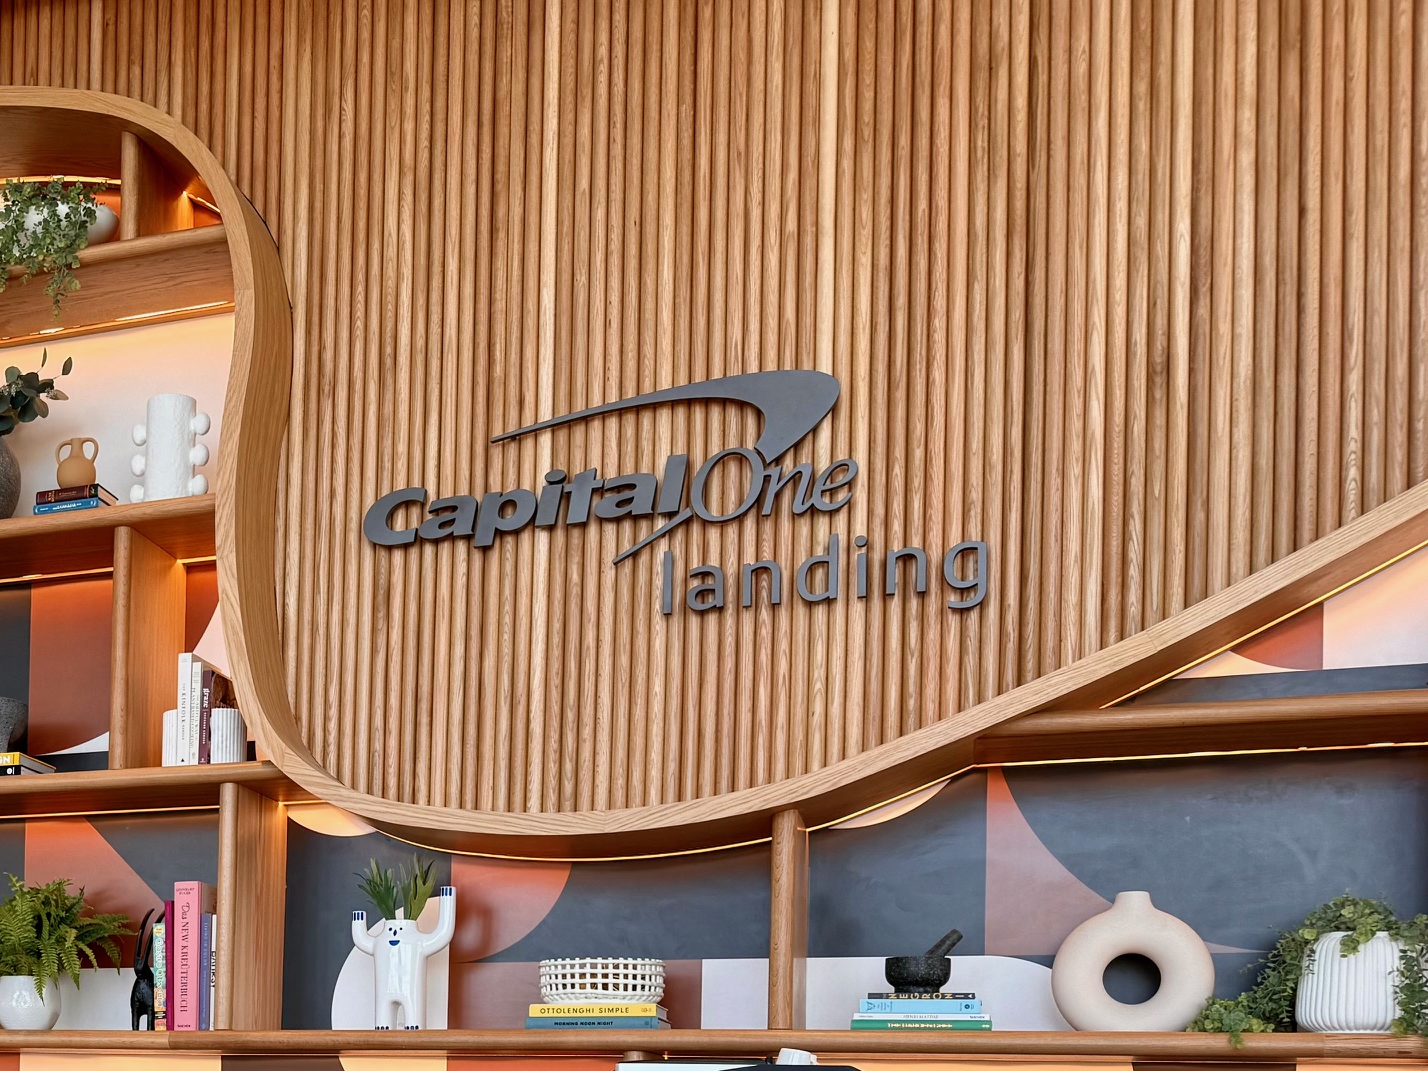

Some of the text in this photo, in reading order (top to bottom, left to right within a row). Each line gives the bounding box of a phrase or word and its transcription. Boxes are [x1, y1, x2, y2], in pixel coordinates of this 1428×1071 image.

[662, 533, 989, 616] landing
[180, 901, 190, 1013] Das NEW KREÜTERBUCH
